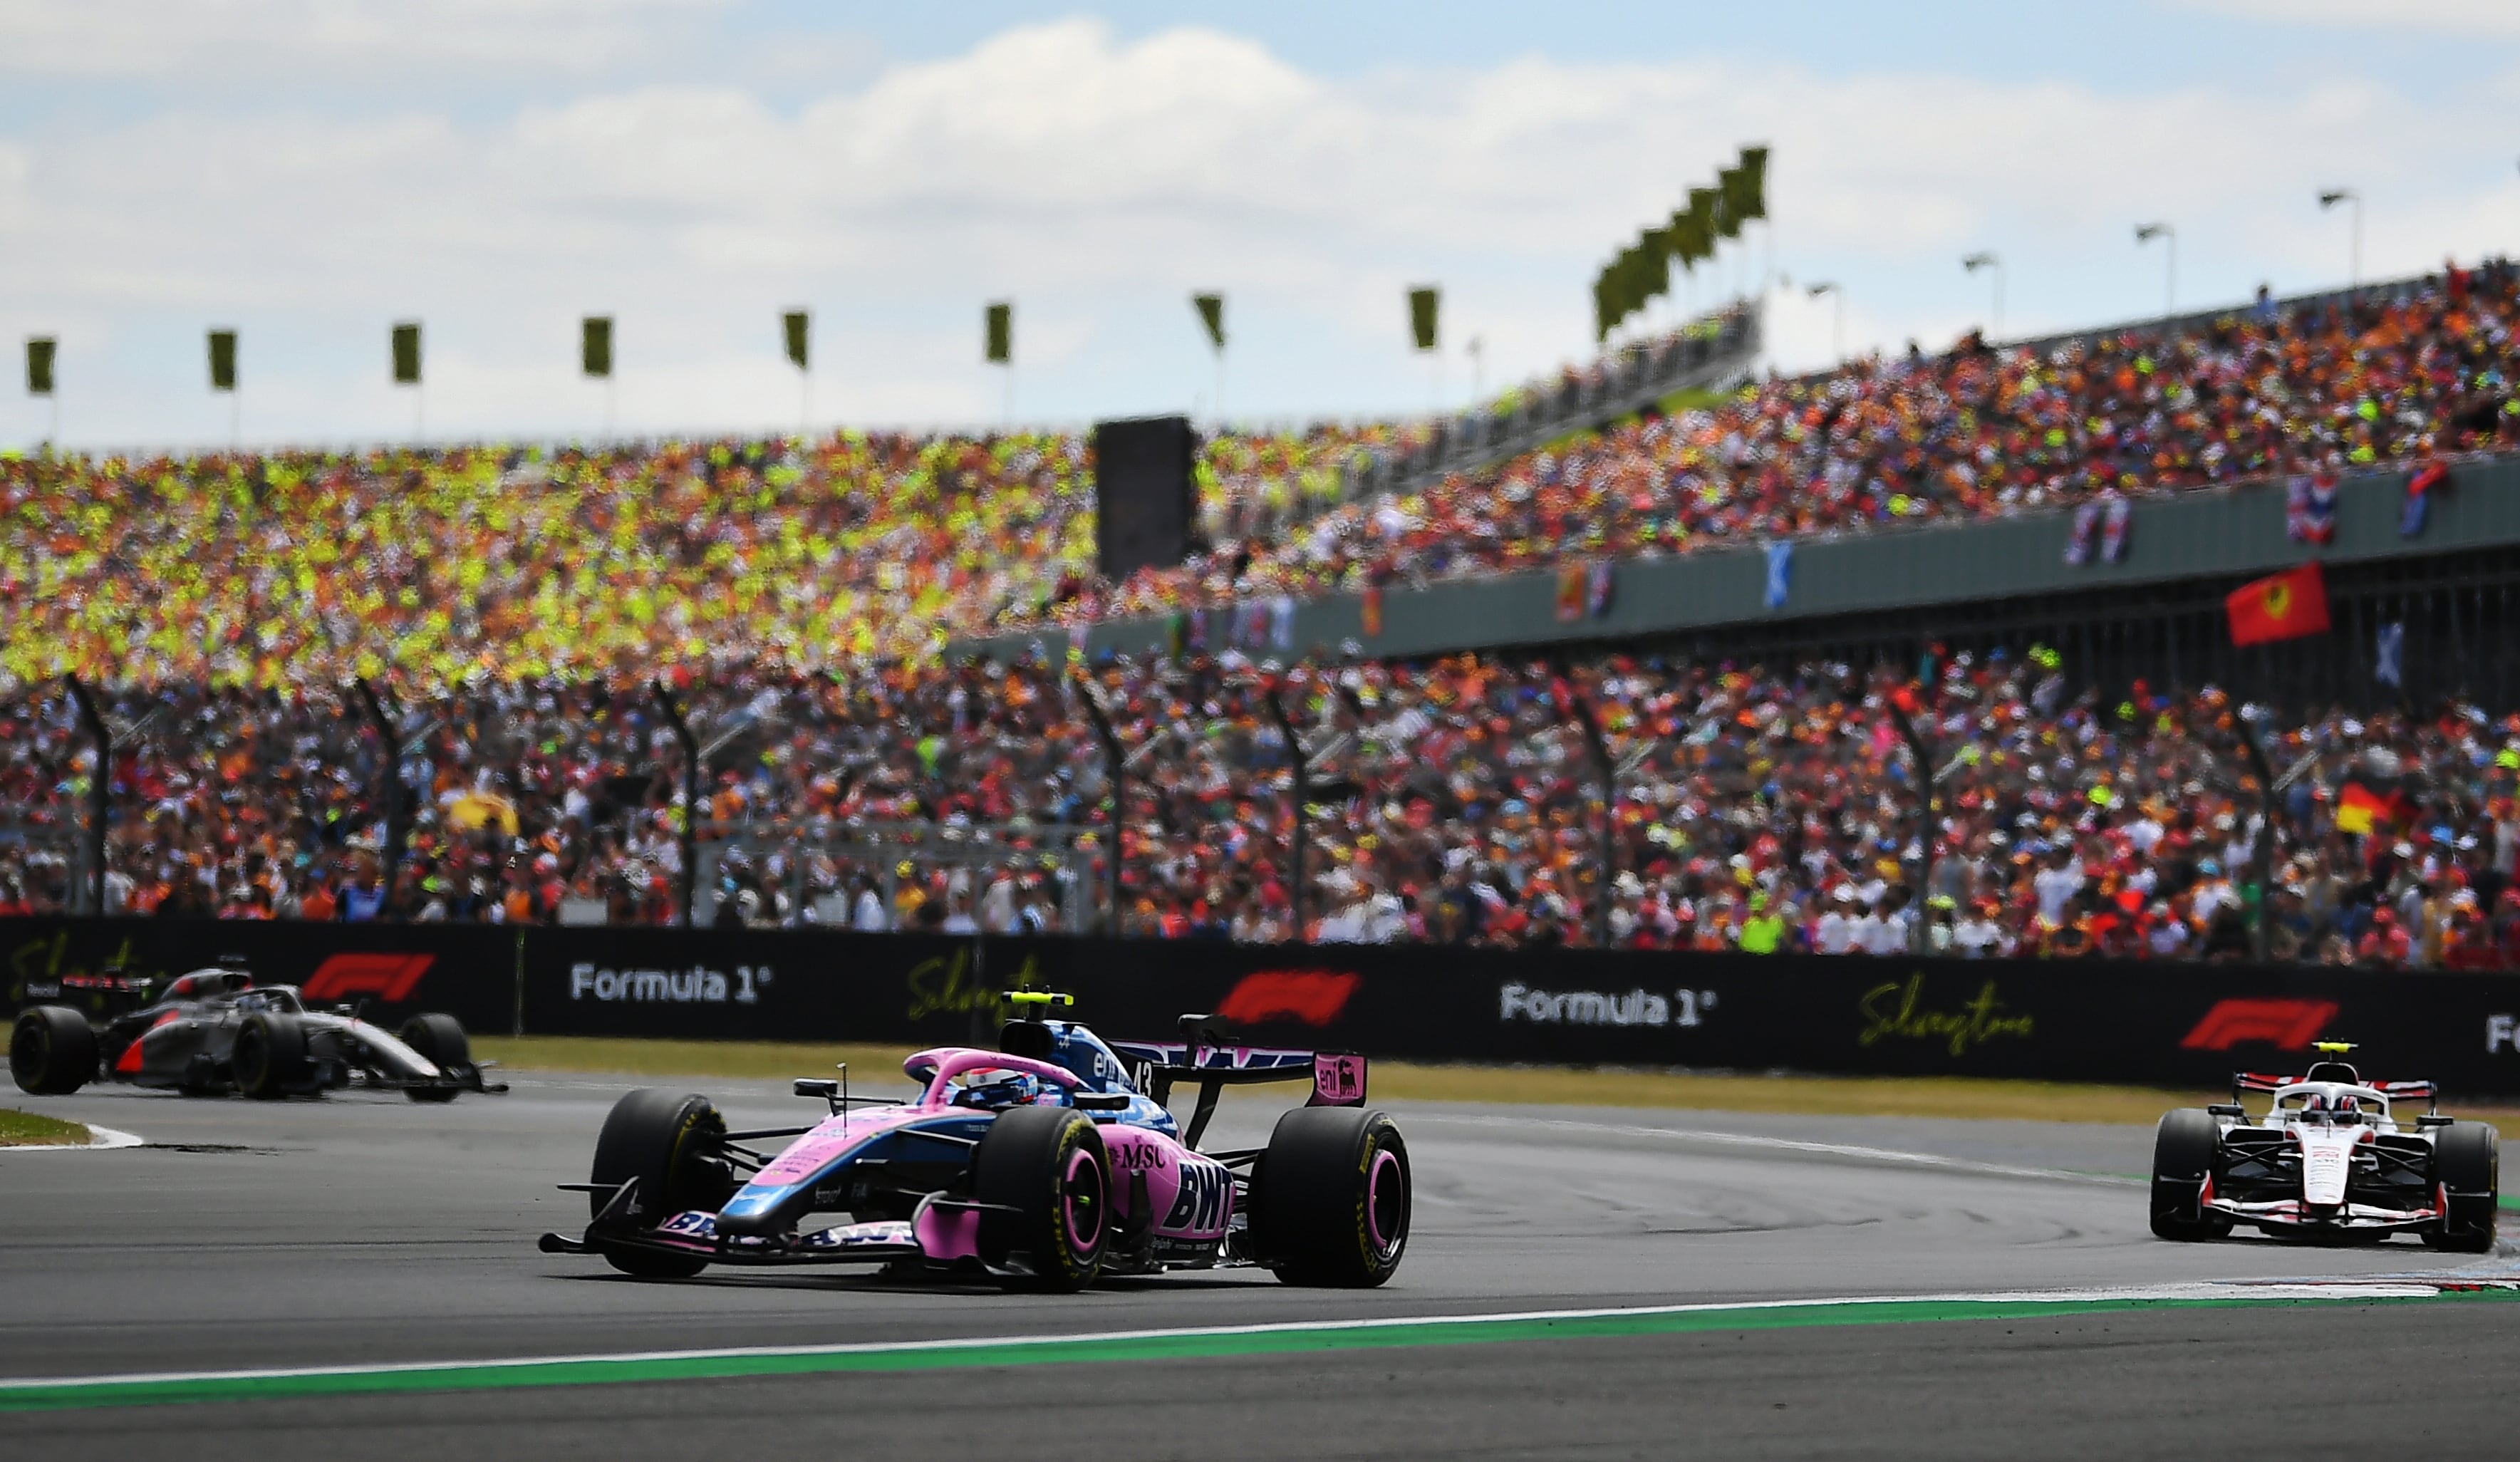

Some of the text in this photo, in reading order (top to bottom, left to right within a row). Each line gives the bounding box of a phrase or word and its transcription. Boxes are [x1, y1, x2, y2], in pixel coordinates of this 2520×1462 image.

[571, 963, 727, 1002] Formula
[1500, 983, 1669, 1026] Formula
[1134, 1061, 1152, 1099] 43
[1320, 1061, 1336, 1091] eni
[1121, 1144, 1166, 1169] MSC
[1160, 1161, 1234, 1234] BWT
